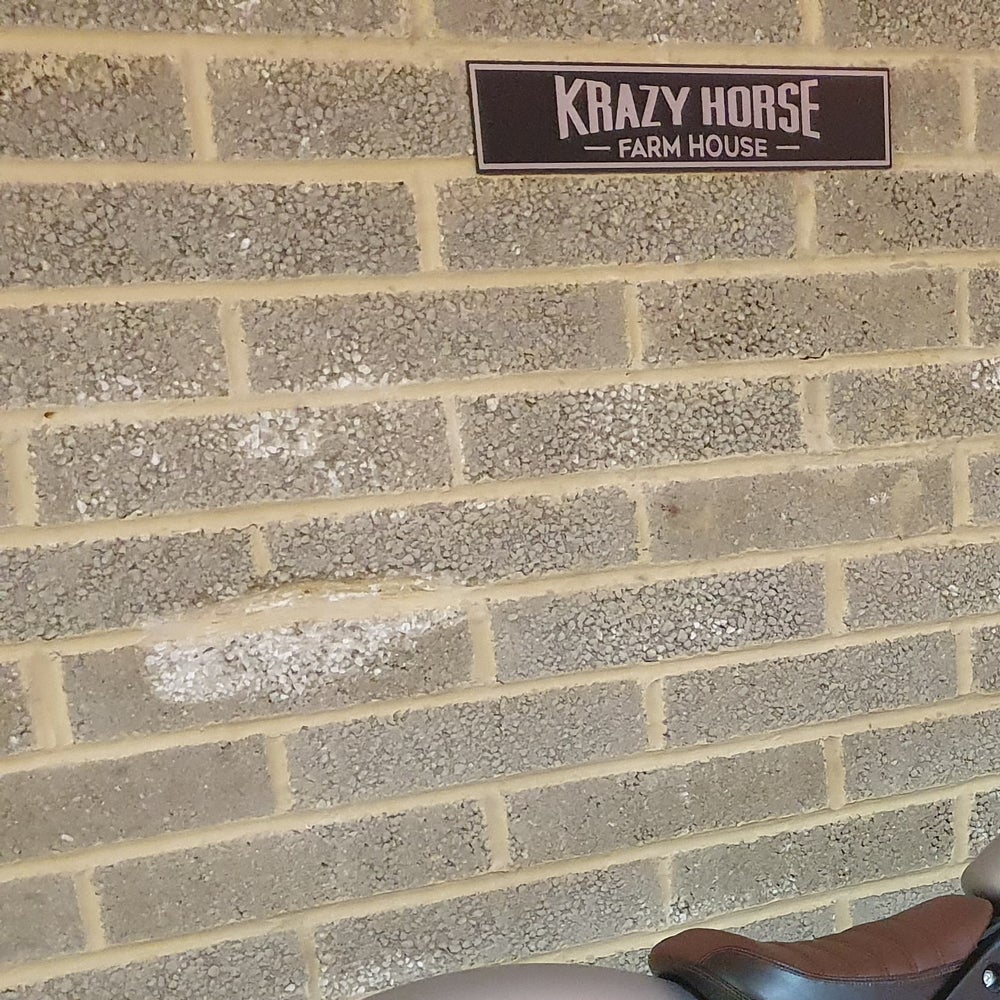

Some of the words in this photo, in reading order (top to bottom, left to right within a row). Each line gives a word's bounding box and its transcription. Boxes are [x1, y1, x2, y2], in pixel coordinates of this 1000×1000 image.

[553, 74, 690, 140] KRAZY
[701, 78, 821, 140] HORSE
[618, 137, 681, 158] FARM
[689, 134, 768, 159] HOUSE
